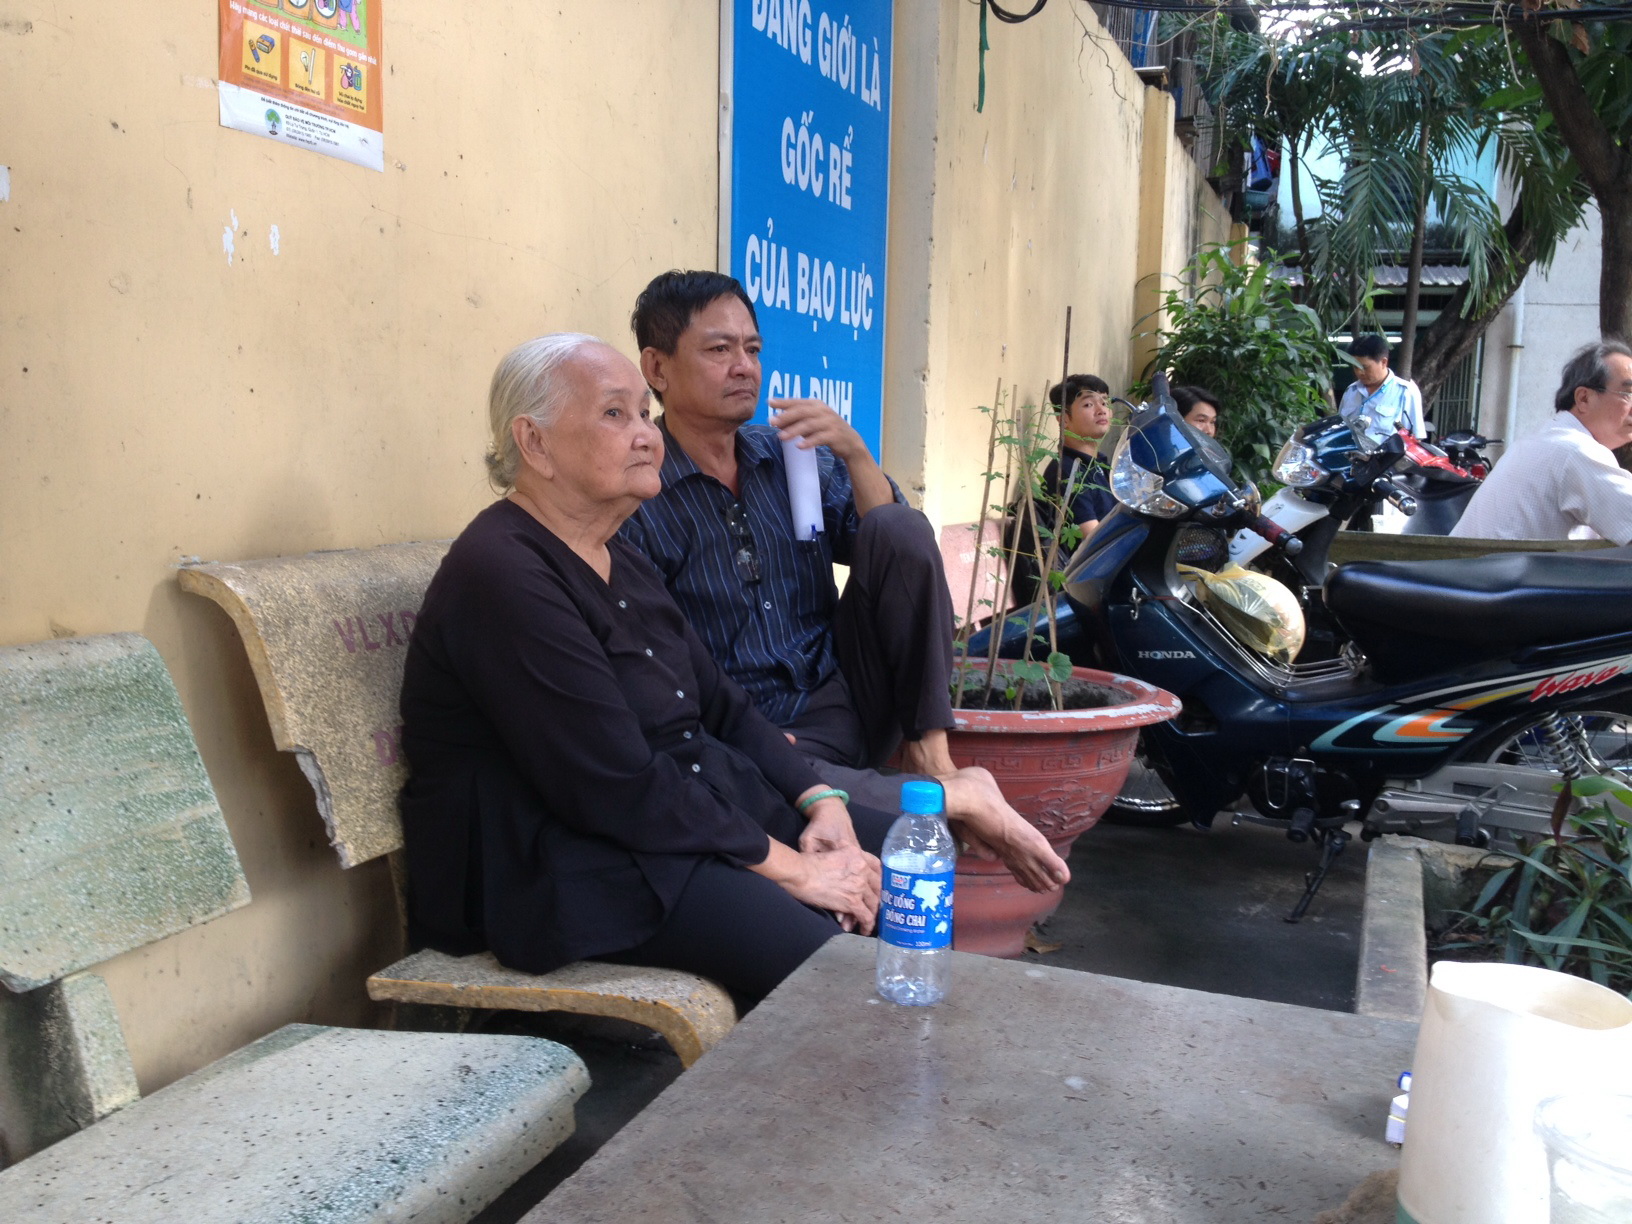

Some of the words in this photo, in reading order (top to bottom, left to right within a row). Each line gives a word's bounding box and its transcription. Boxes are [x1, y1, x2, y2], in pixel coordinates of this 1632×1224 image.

[818, 12, 856, 95] GIỚI
[861, 36, 881, 112] LÀ
[781, 110, 824, 197] GỐC
[745, 217, 790, 310] CỦA
[797, 252, 835, 332] BẠO
[840, 263, 873, 341] LỰC
[1138, 651, 1196, 659] HONDA
[1529, 665, 1628, 702] Wave
[906, 914, 926, 927] CHAI
